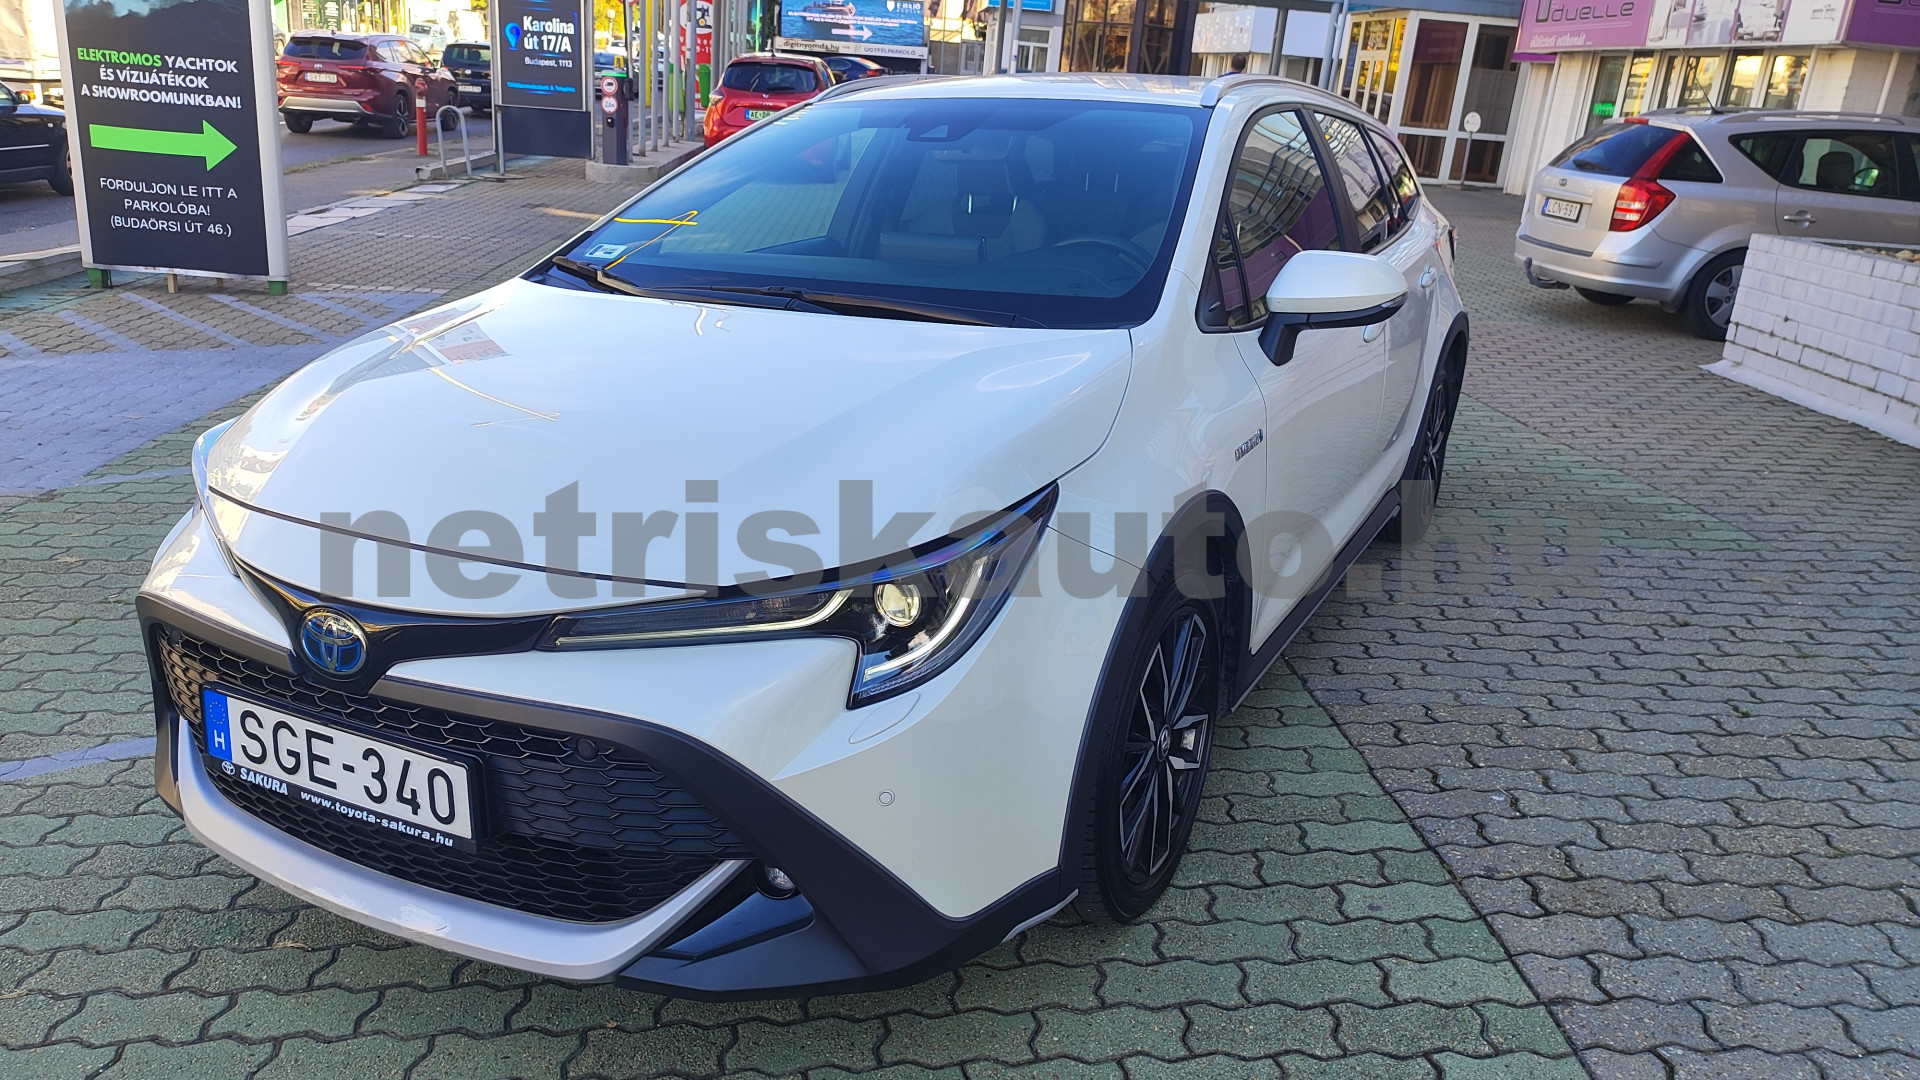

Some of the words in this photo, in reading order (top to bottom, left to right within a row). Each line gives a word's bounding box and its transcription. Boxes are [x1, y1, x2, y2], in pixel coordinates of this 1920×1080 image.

[523, 16, 575, 35] Karolina
[523, 33, 540, 50] út
[541, 35, 572, 53] 17/A
[783, 40, 840, 52] digitnyomda.hu
[77, 47, 162, 67] ELEKTROMOS
[164, 55, 239, 73] YACHTOK
[524, 56, 558, 68] Budapest,
[558, 59, 573, 68] 1113
[99, 65, 115, 81] ÉS
[116, 66, 209, 89] VÍZIJÁTÉKOK
[81, 84, 91, 97] A
[91, 85, 242, 109] SHOWROOMUNKBAN!
[100, 177, 177, 196] FORDULJON
[181, 185, 198, 197] LE
[202, 186, 223, 198] ITT
[227, 188, 238, 199] A
[124, 199, 211, 216] PARKOLÓBA!
[1547, 201, 1578, 218] LCN-591
[110, 215, 181, 232] (BUDAÖRSI
[184, 220, 203, 233] ÚT
[207, 223, 232, 237] 46.)
[213, 729, 226, 751] H
[239, 709, 456, 825] SGE-340
[240, 767, 289, 797] SAKURA
[300, 791, 454, 848] www.toyota-sakura.hu
